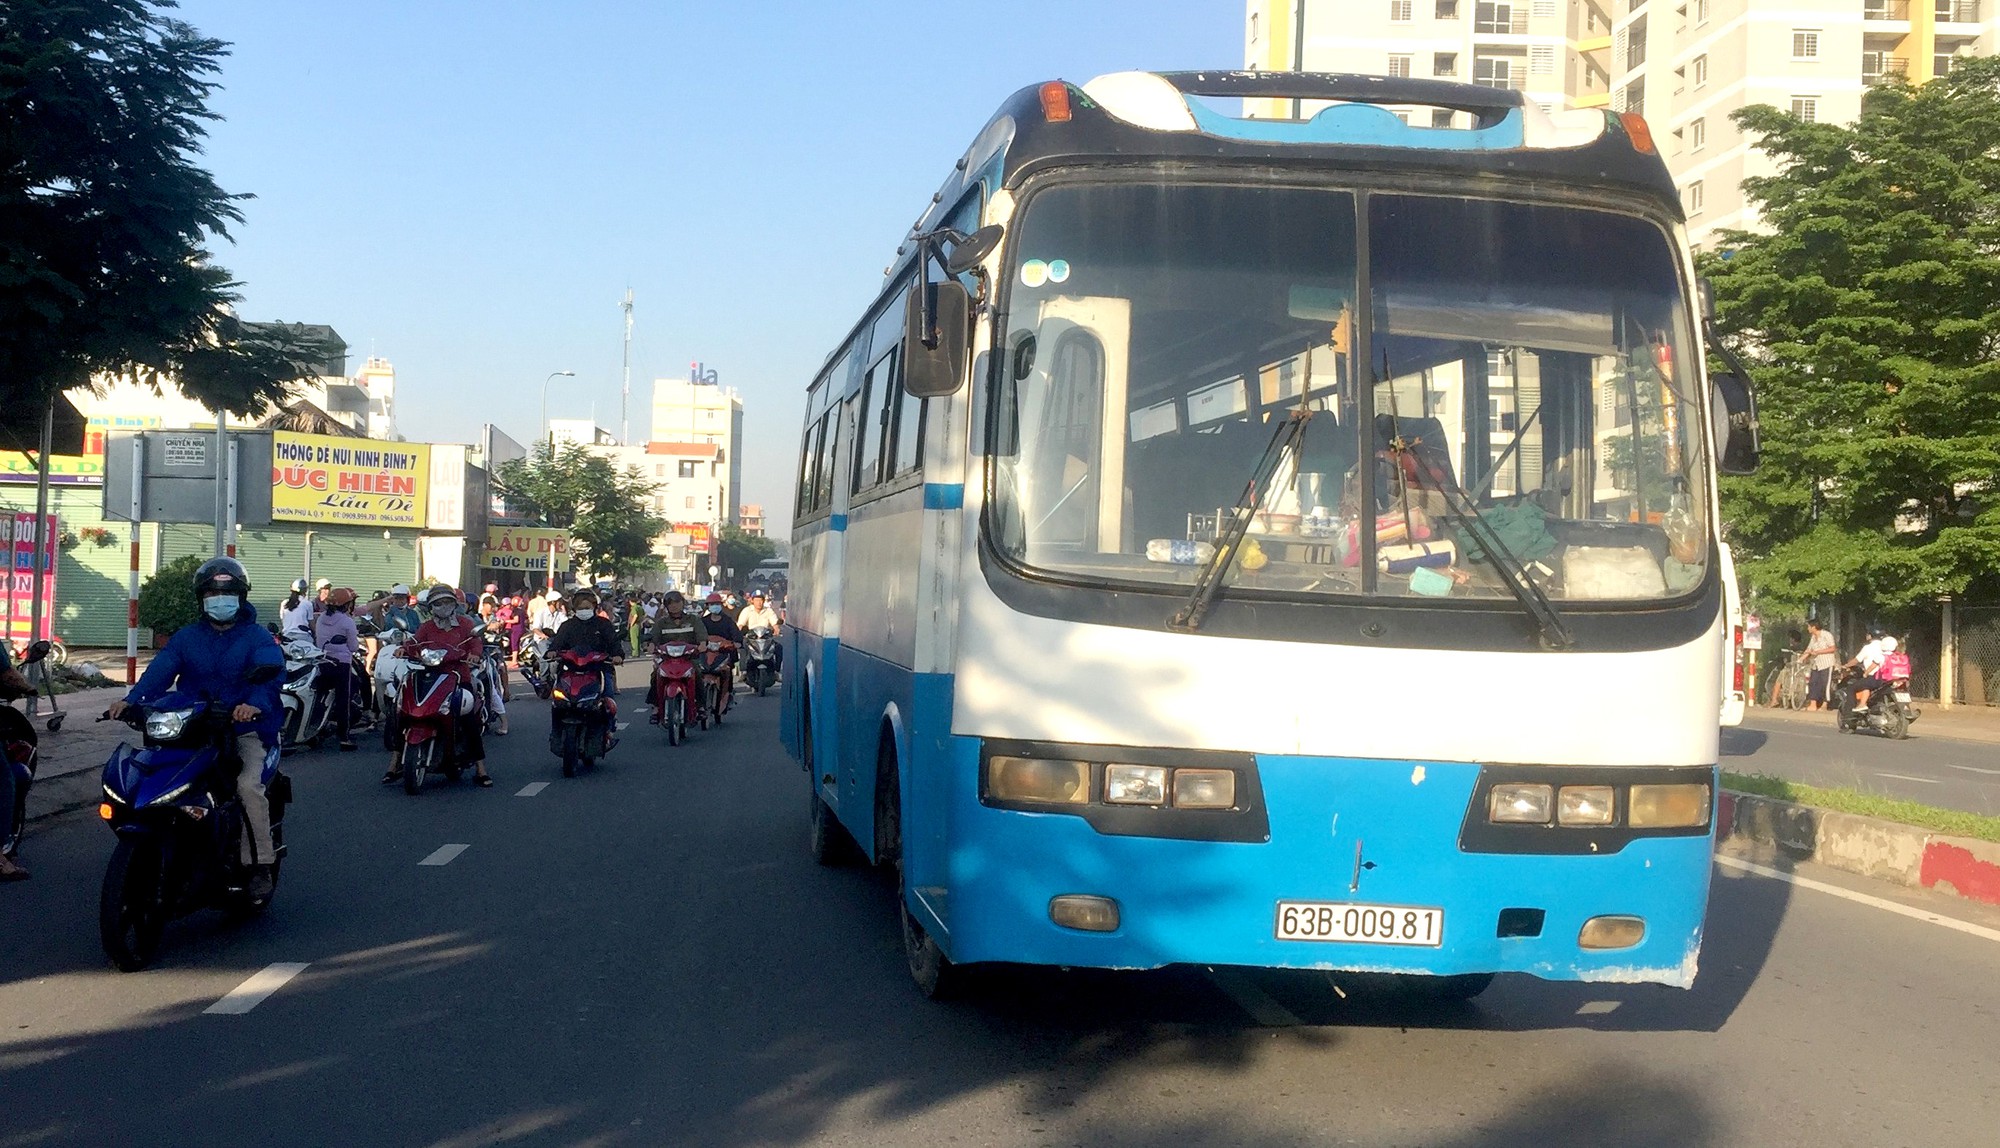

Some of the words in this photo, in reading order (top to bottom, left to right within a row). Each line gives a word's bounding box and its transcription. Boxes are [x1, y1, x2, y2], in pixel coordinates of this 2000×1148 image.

[691, 361, 718, 386] ila
[354, 449, 380, 468] NINH
[410, 454, 417, 470] 7
[537, 534, 567, 554] DÊ
[1282, 906, 1434, 941] 63B-009.81
